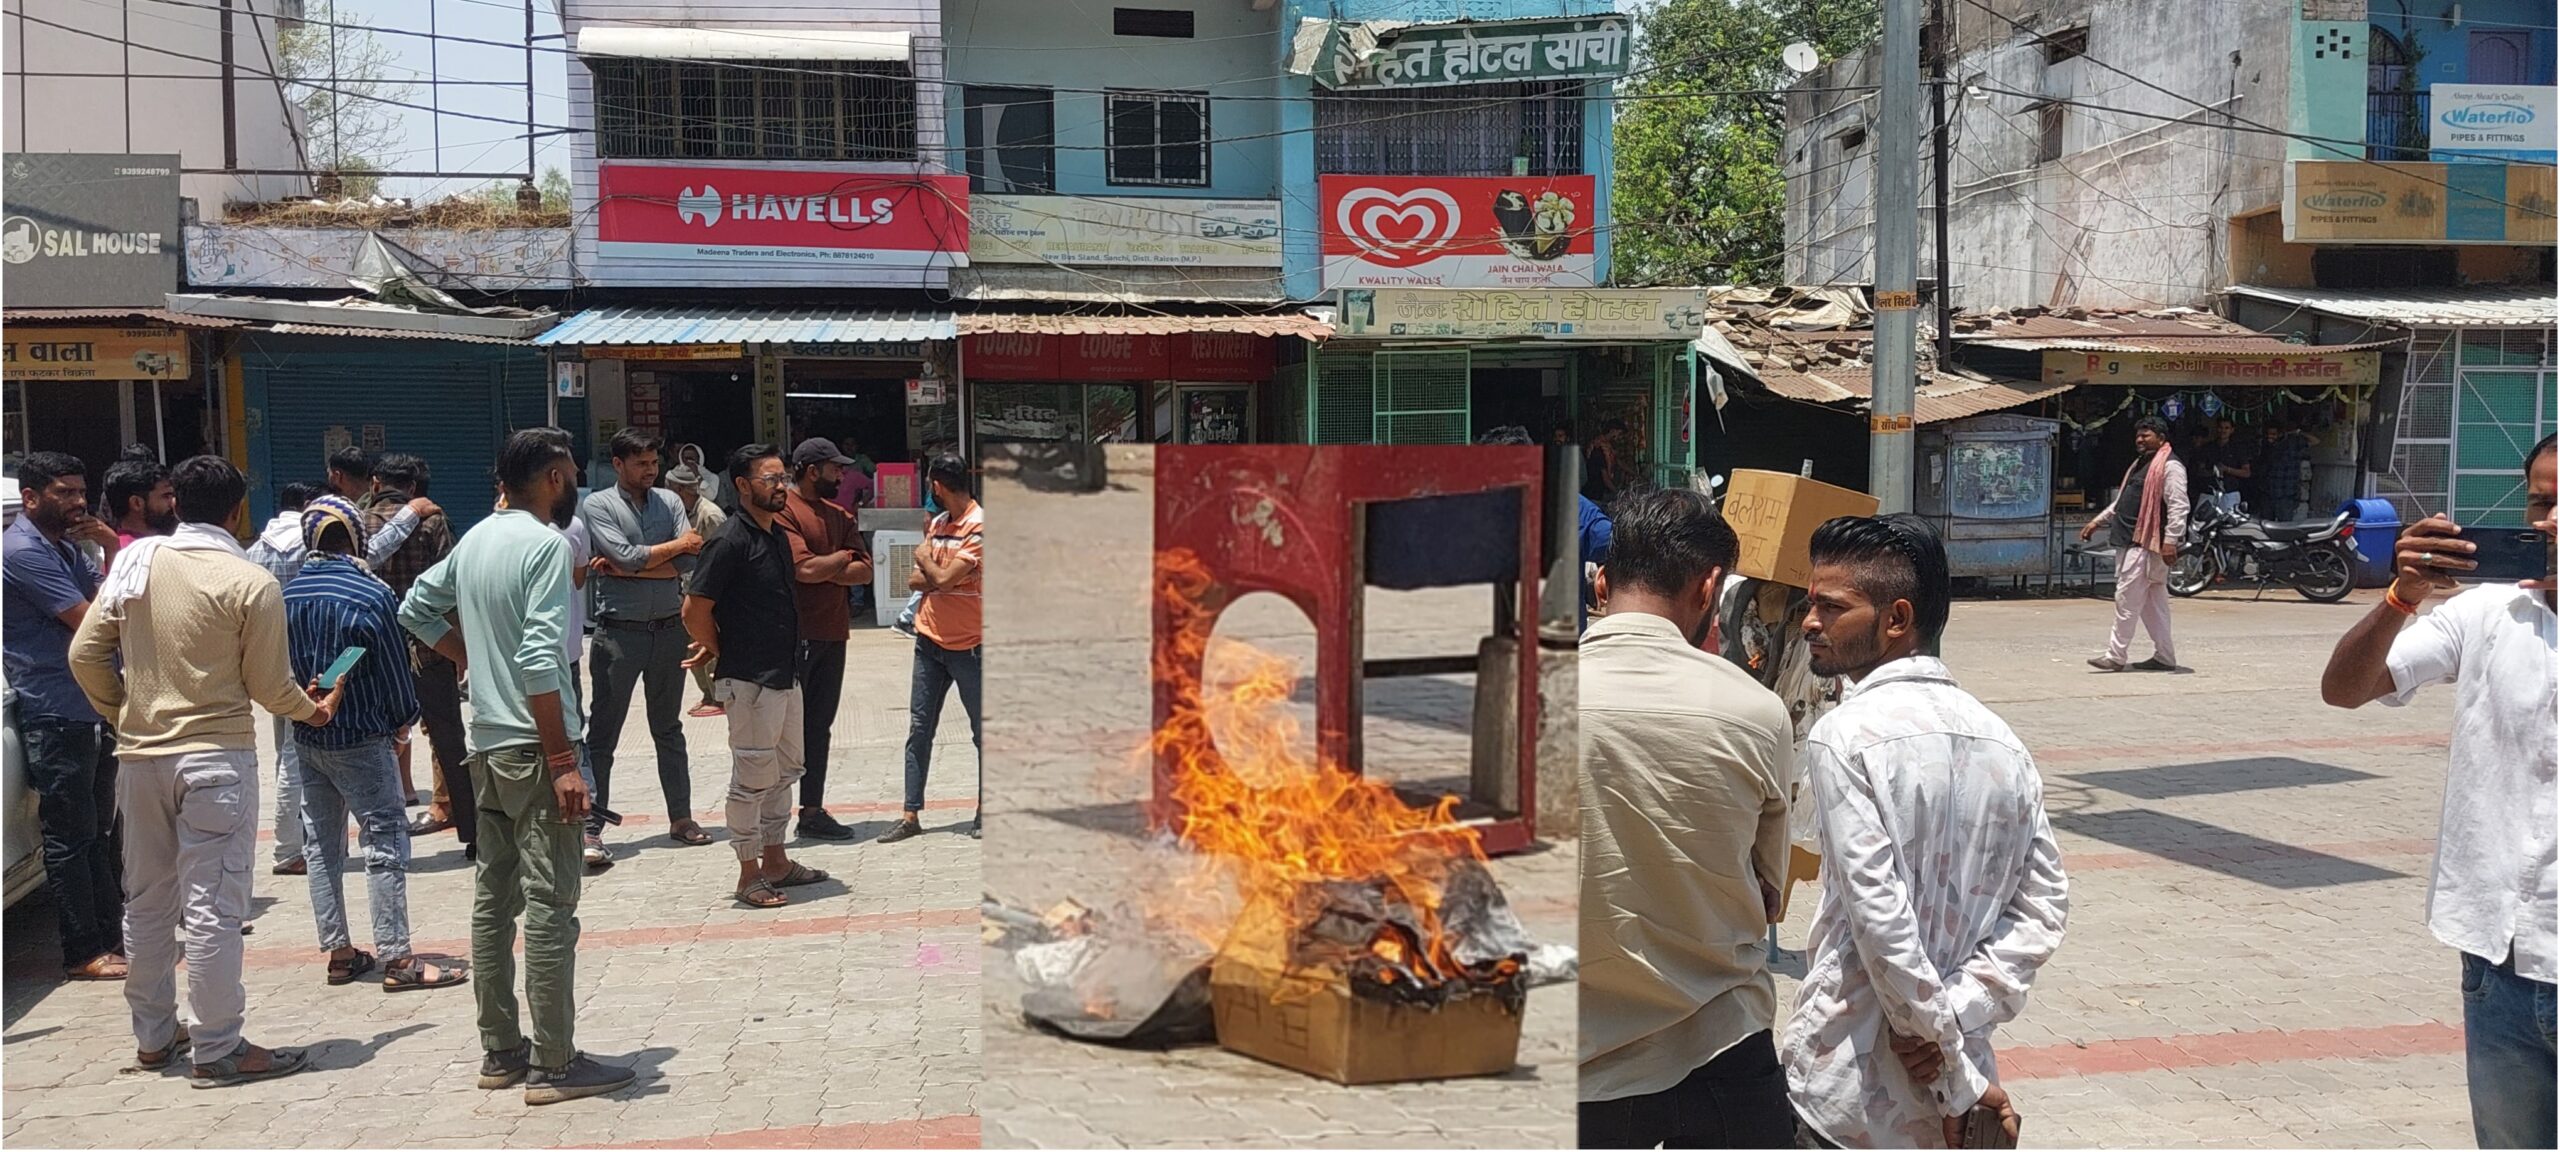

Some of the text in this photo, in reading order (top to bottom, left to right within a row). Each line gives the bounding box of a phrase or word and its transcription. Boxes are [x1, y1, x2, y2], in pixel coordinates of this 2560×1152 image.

[1441, 27, 1542, 83] होटल
[2451, 107, 2528, 124] Waterflo
[2451, 133, 2525, 142] PIPES & FITTINGS
[2312, 193, 2379, 208] Waterflo
[732, 194, 893, 225] HAVELLS
[2310, 215, 2333, 223] PIPES
[2335, 215, 2341, 223] &
[44, 229, 161, 257] SAL HOUSE
[697, 248, 730, 256] Madeena
[732, 249, 759, 257] Traders
[776, 250, 818, 258] Electronics,
[1487, 264, 1563, 274] JAIN CHAI WALA
[1358, 276, 1441, 285] KWALITY WALL'S
[1395, 291, 1662, 321] जैन रोहित होटल
[28, 342, 94, 362] वाला
[975, 333, 1044, 357] TOURIST
[1080, 334, 1133, 358] LODGE
[1148, 336, 1163, 357] &
